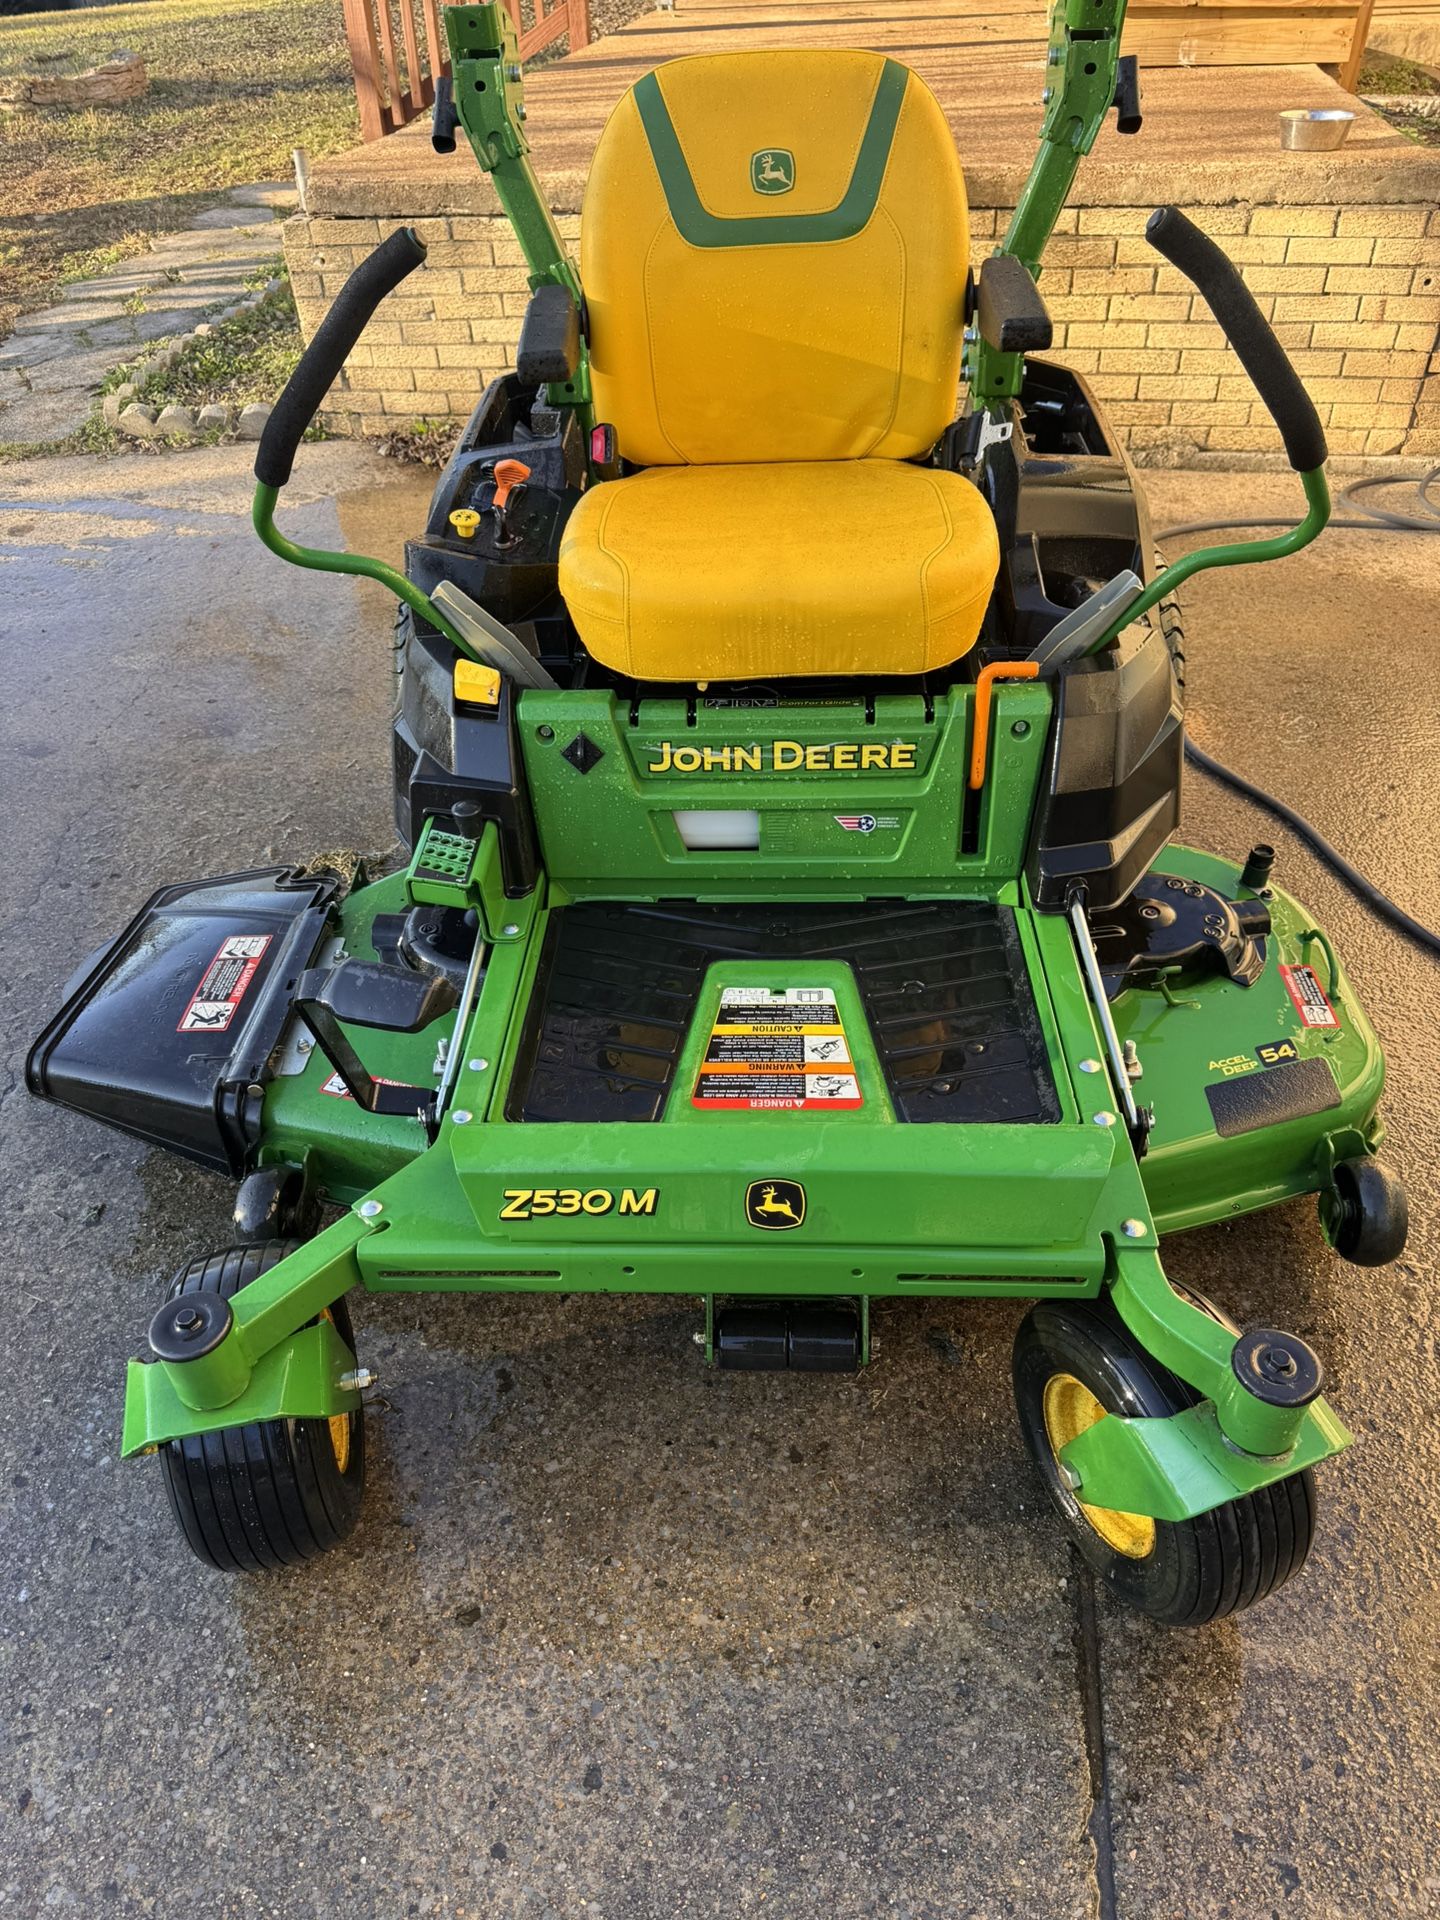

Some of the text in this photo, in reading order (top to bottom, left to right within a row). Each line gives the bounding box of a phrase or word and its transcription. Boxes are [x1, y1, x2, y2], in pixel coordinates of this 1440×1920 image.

[648, 740, 917, 773] JOHN DEERE
[232, 968, 254, 998] DANGER
[1260, 1043, 1297, 1063] 54
[748, 1063, 795, 1071] WARNING
[1208, 1054, 1252, 1071] ACCEL
[1222, 1060, 1259, 1076] DEEP
[750, 1099, 793, 1108] DANGER
[500, 1188, 657, 1219] Z530 M
